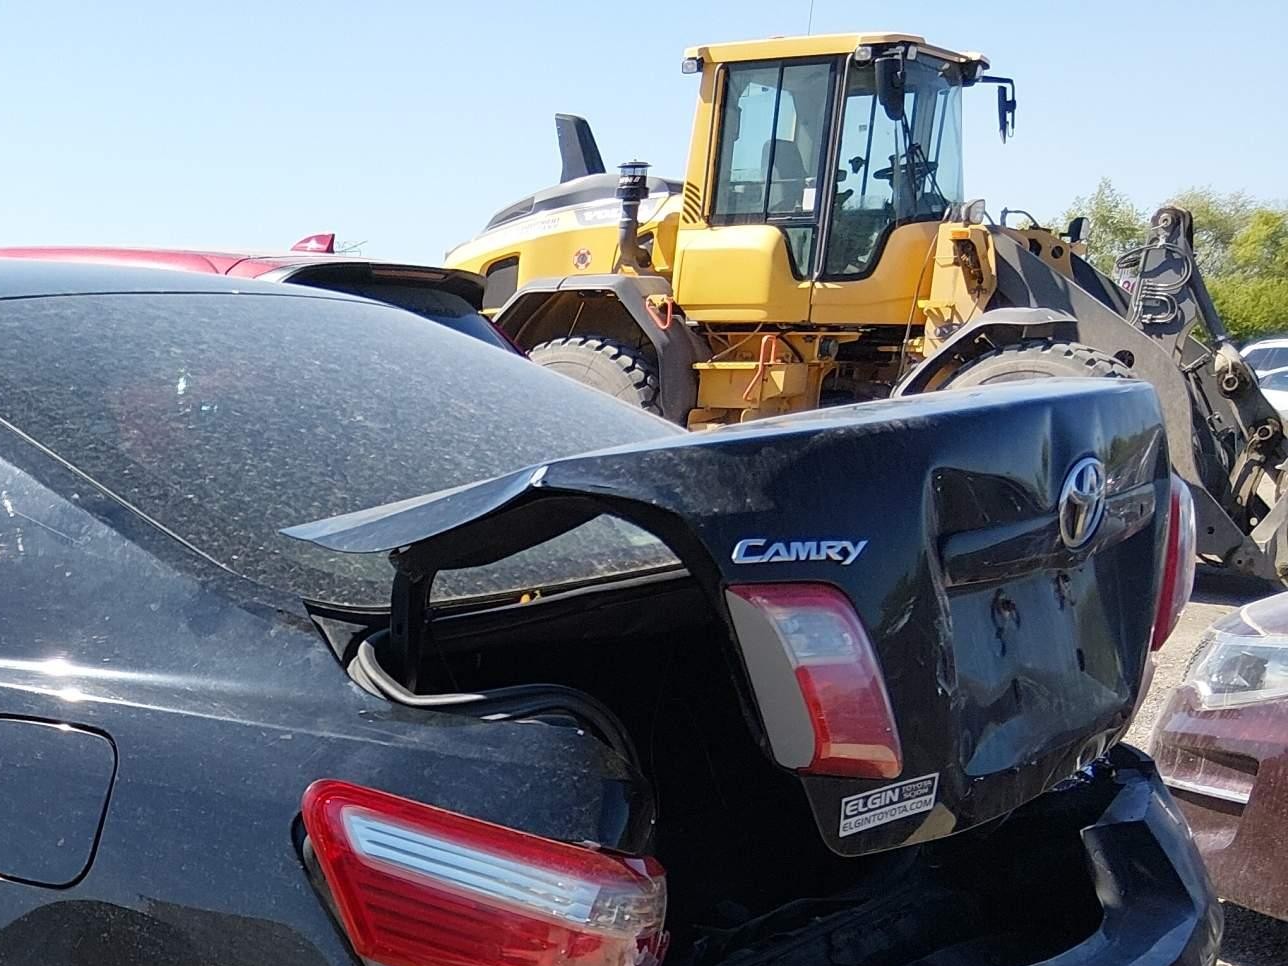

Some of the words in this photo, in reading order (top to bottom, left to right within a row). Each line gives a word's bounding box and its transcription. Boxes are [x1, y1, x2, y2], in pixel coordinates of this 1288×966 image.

[731, 538, 869, 565] CAMRY
[841, 797, 932, 832] ELGINTOYOTA.COM
[845, 787, 900, 817] ELGIN
